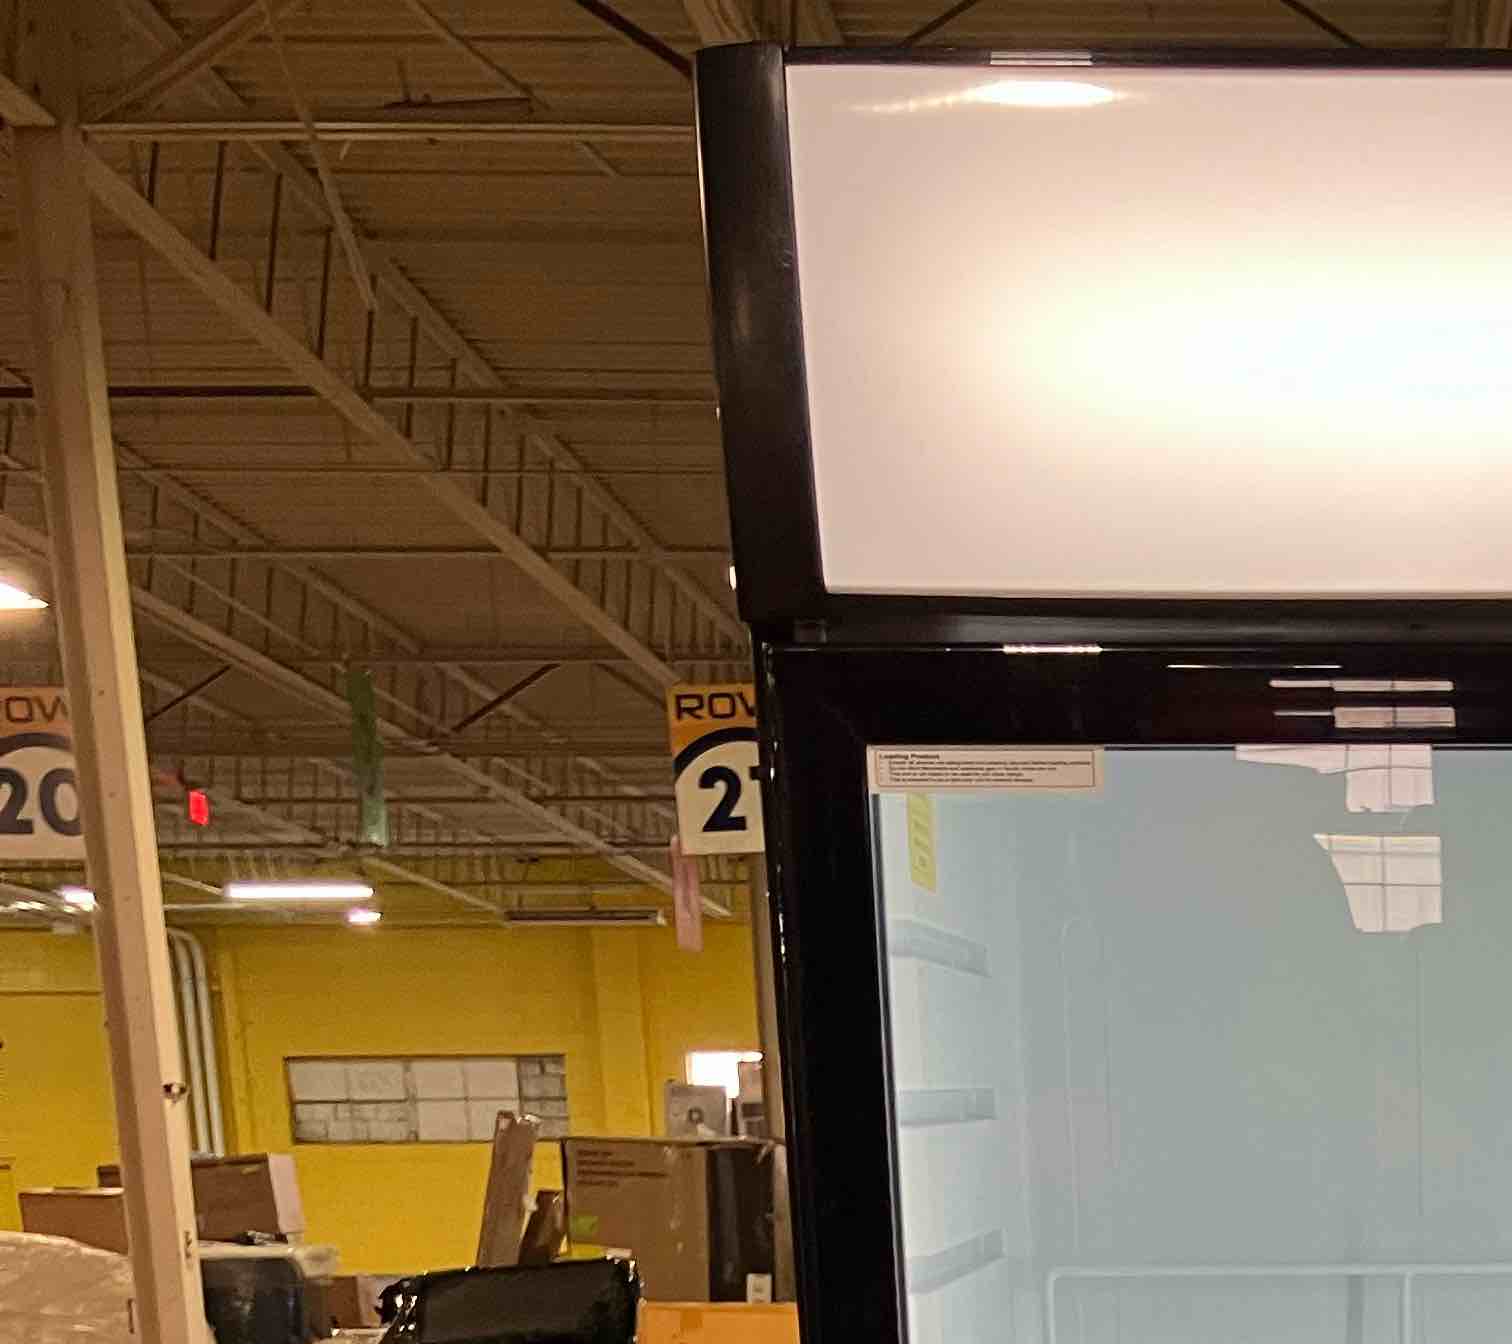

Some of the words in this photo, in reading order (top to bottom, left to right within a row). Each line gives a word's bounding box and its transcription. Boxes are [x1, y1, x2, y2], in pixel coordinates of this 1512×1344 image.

[675, 691, 757, 720] RO
[0, 767, 83, 836] 20
[698, 765, 761, 833] 2
